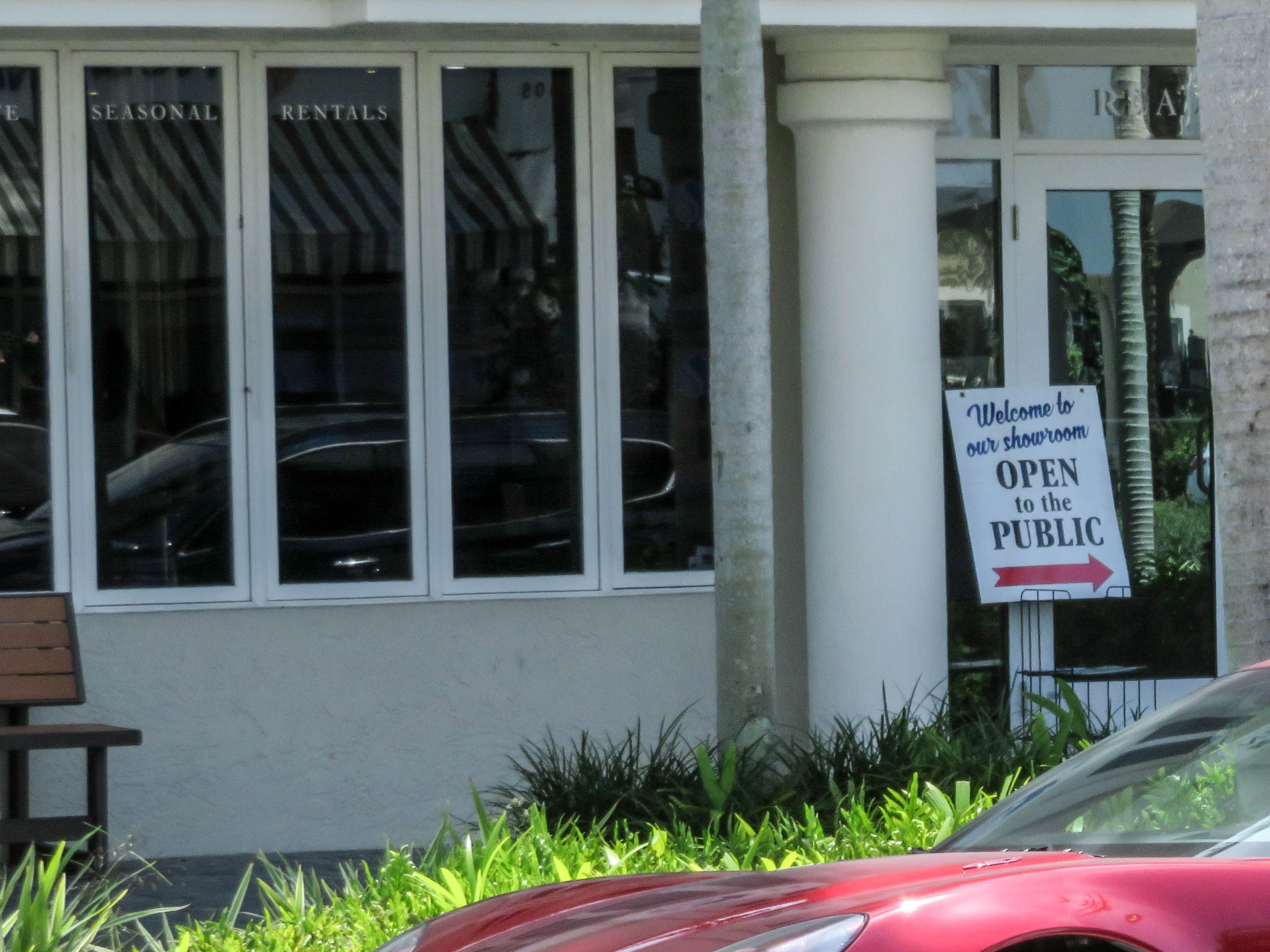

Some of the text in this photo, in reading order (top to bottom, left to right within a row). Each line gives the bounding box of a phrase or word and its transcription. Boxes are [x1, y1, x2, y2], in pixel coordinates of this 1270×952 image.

[91, 104, 218, 121] SEASONAL
[281, 104, 389, 122] RENTALS
[967, 391, 1075, 428] Welcome to
[966, 425, 1089, 458] our showroom
[996, 457, 1080, 490] OPEN
[1015, 491, 1073, 514] to the
[989, 516, 1105, 551] PUBLIC
